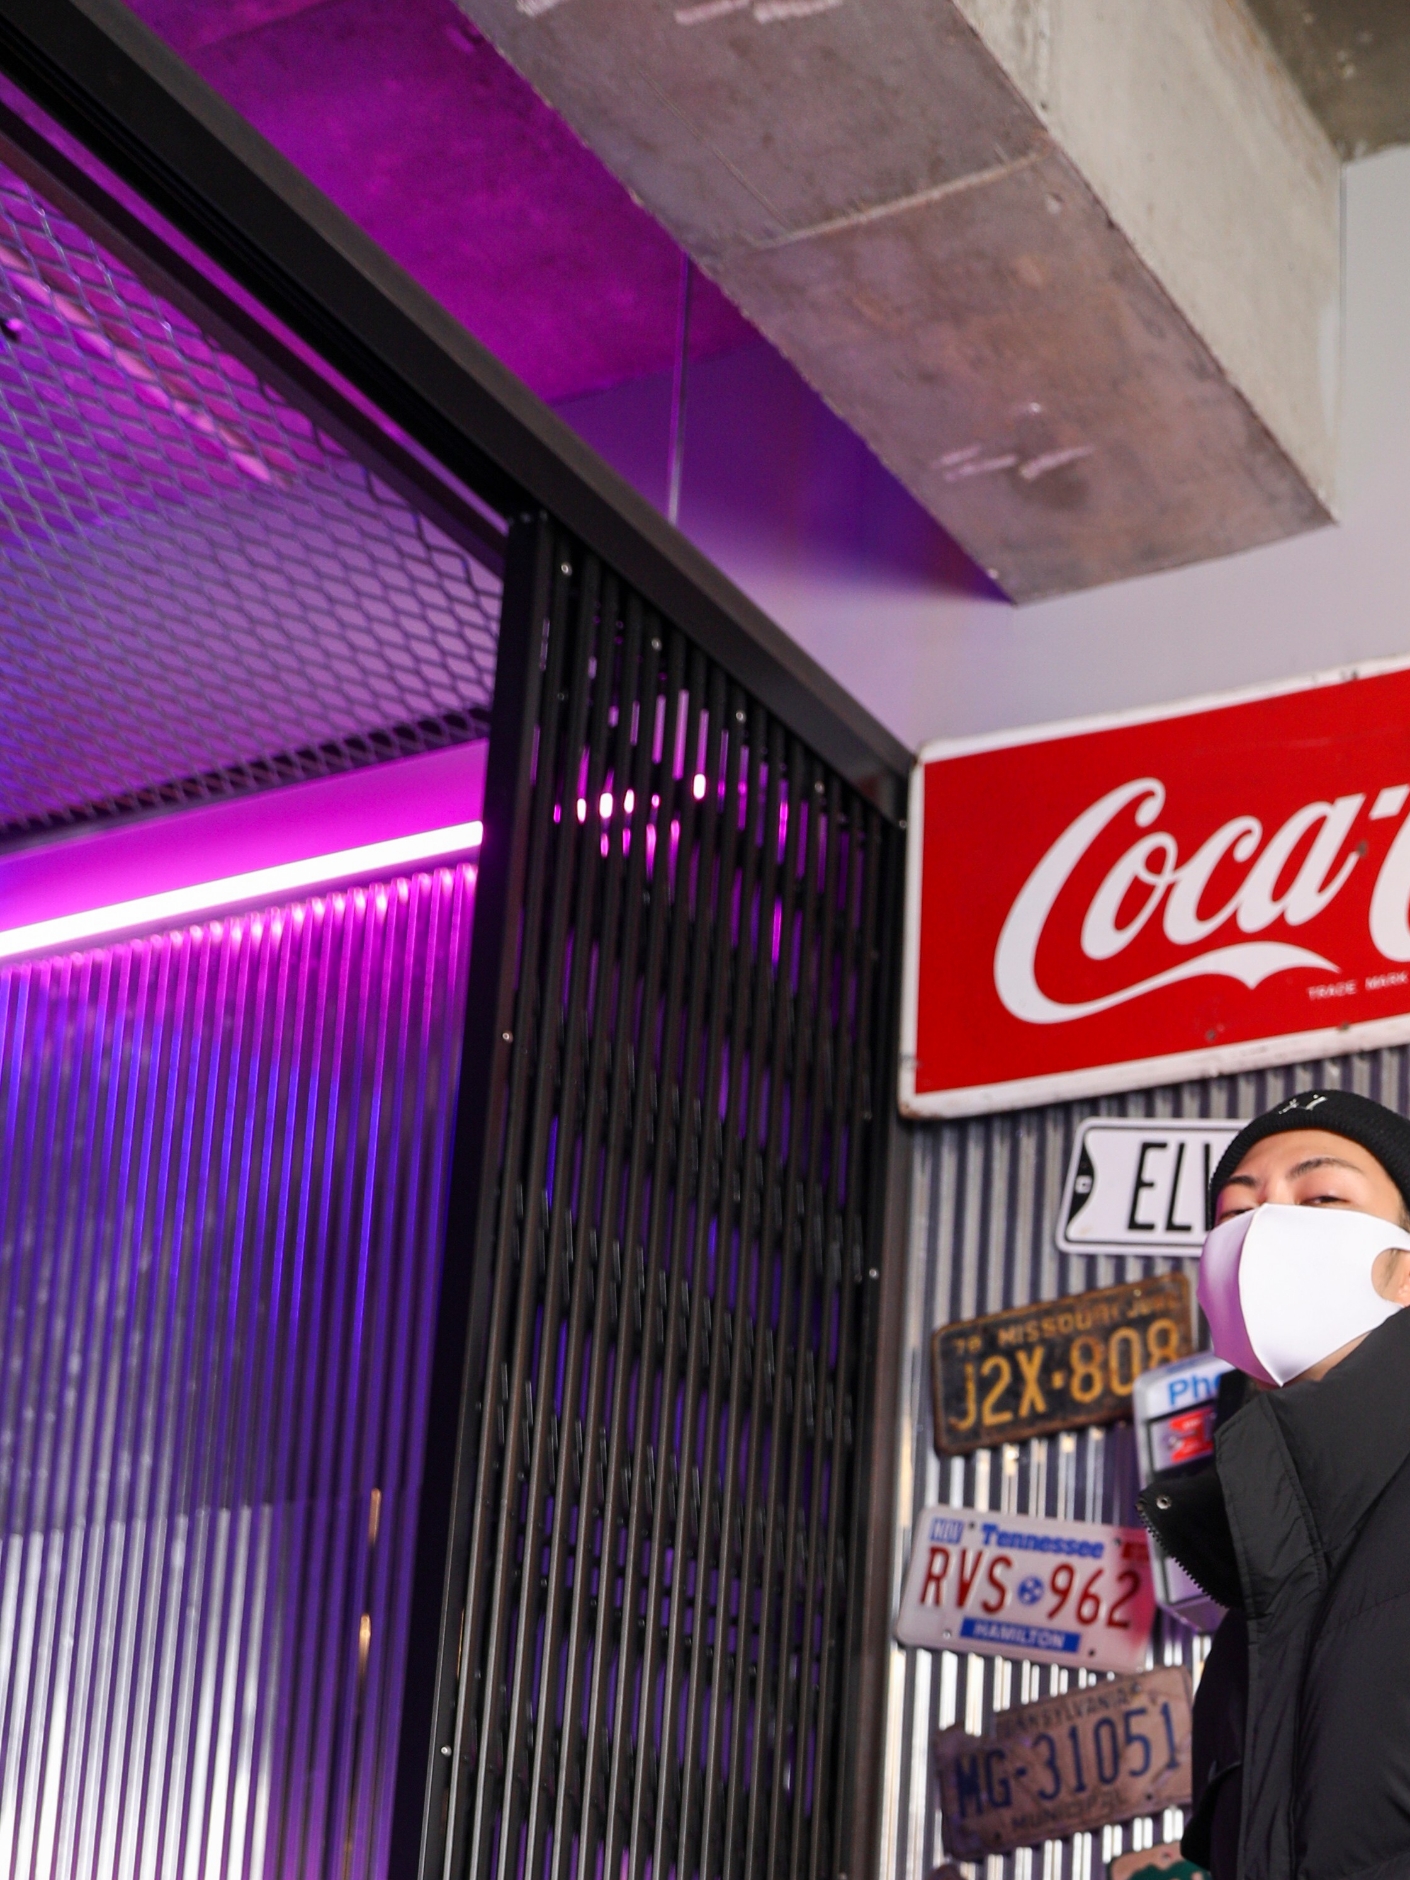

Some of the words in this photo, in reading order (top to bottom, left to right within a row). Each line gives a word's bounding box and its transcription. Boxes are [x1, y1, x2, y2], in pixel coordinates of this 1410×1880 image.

[1307, 978, 1358, 1001] TRADE
[1364, 970, 1409, 991] MARK
[998, 1304, 1120, 1347] MISSOURI
[980, 1522, 1105, 1560] Tennessee
[920, 1546, 1013, 1614] RVS
[1047, 1562, 1141, 1629] 962
[973, 1621, 1067, 1651] HAMILTON
[954, 1700, 1181, 1819] MG-31051
